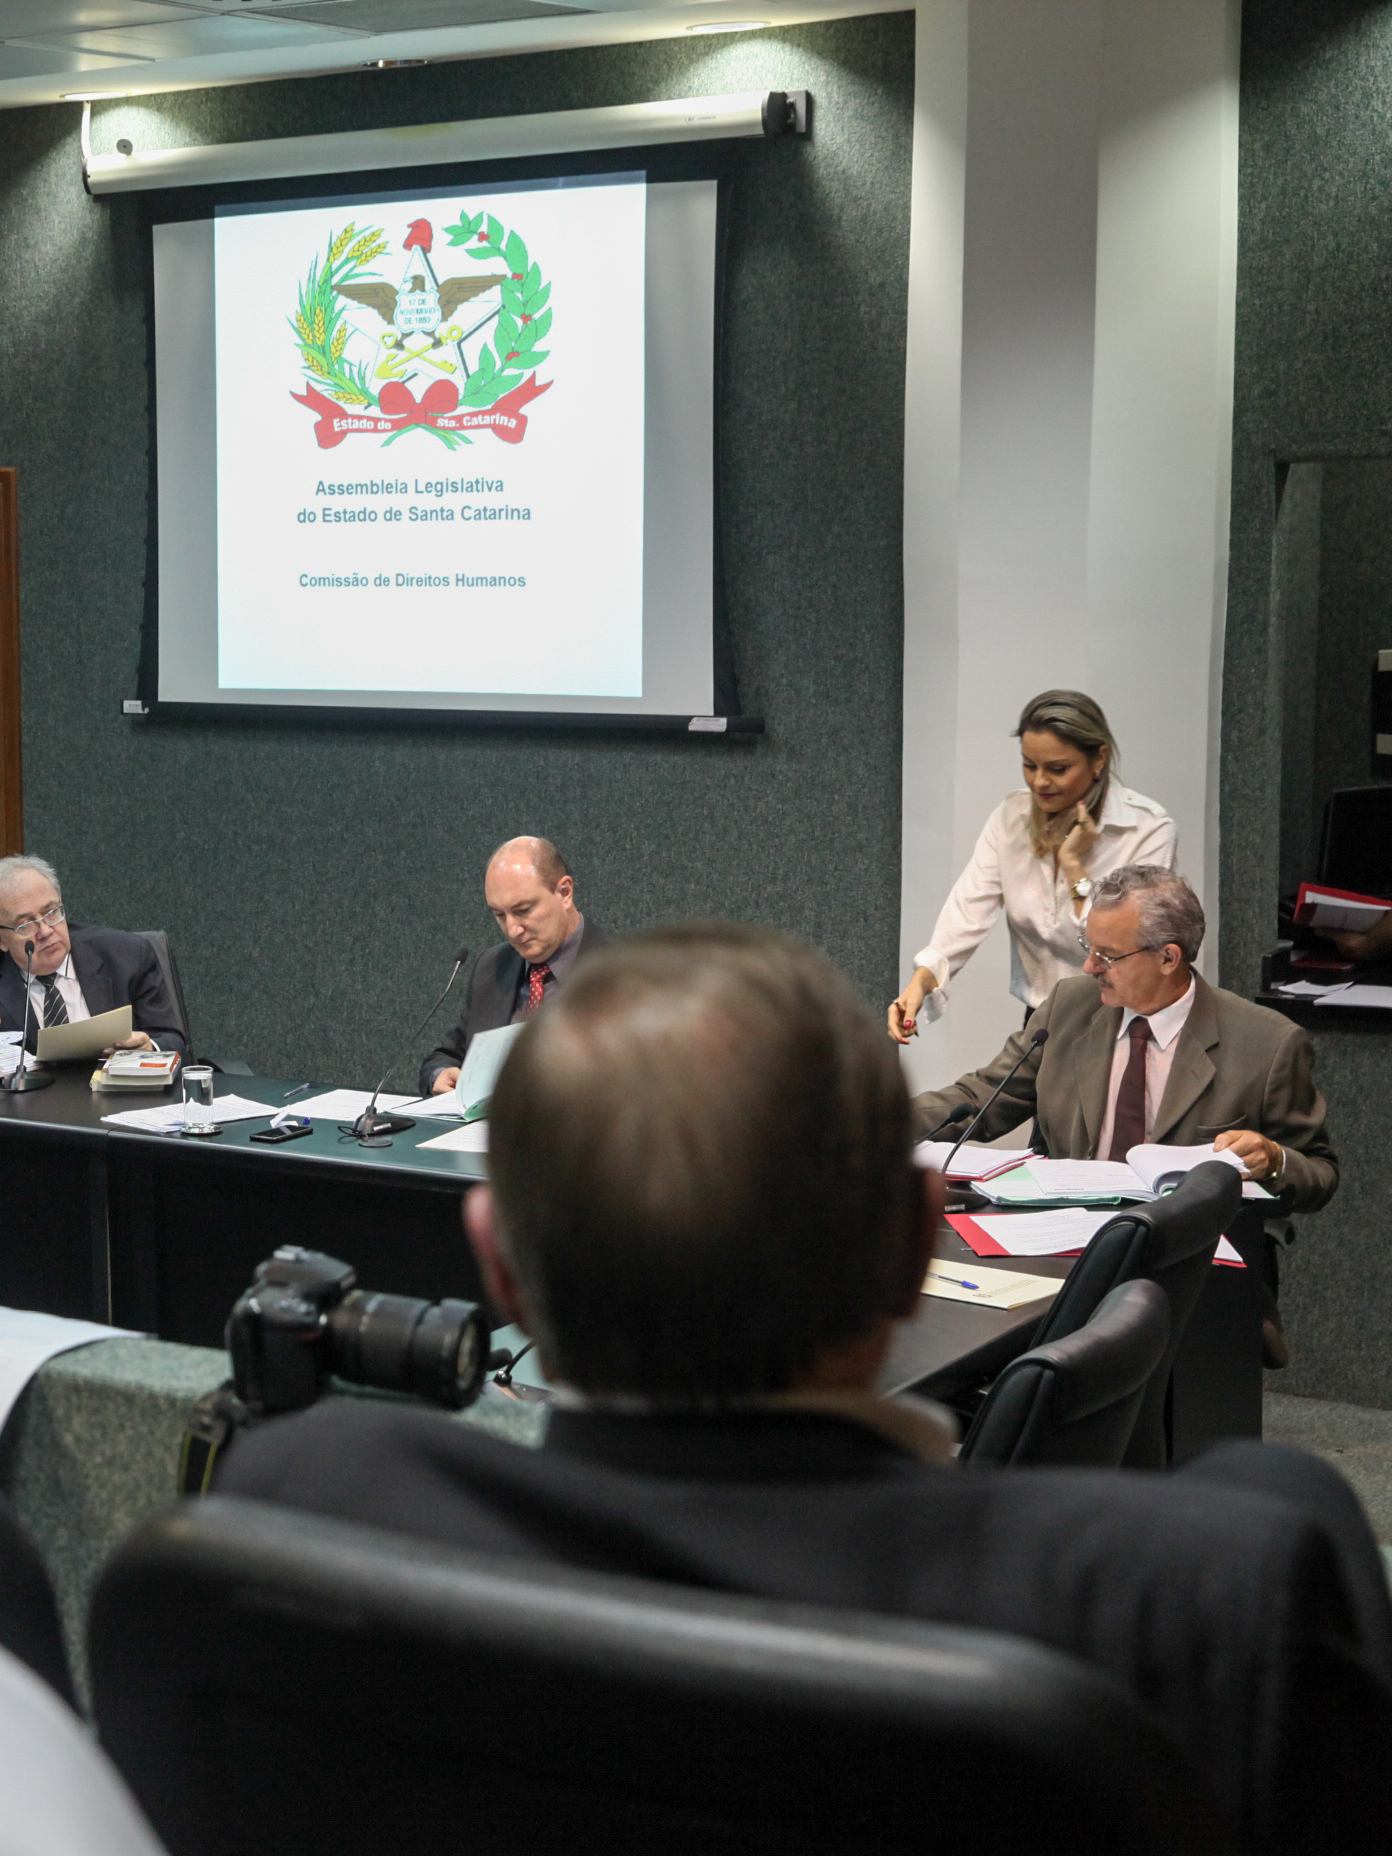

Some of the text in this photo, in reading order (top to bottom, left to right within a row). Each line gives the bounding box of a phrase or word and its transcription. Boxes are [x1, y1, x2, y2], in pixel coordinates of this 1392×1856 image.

[418, 298, 426, 306] DE
[404, 317, 412, 325] DE
[333, 413, 517, 432] Estado de Sta. Catarina
[315, 477, 504, 498] Assembleia Legislativa
[297, 504, 531, 524] do Estado de Santa Catarina
[299, 572, 526, 588] Comissão de Direitos Humanos
